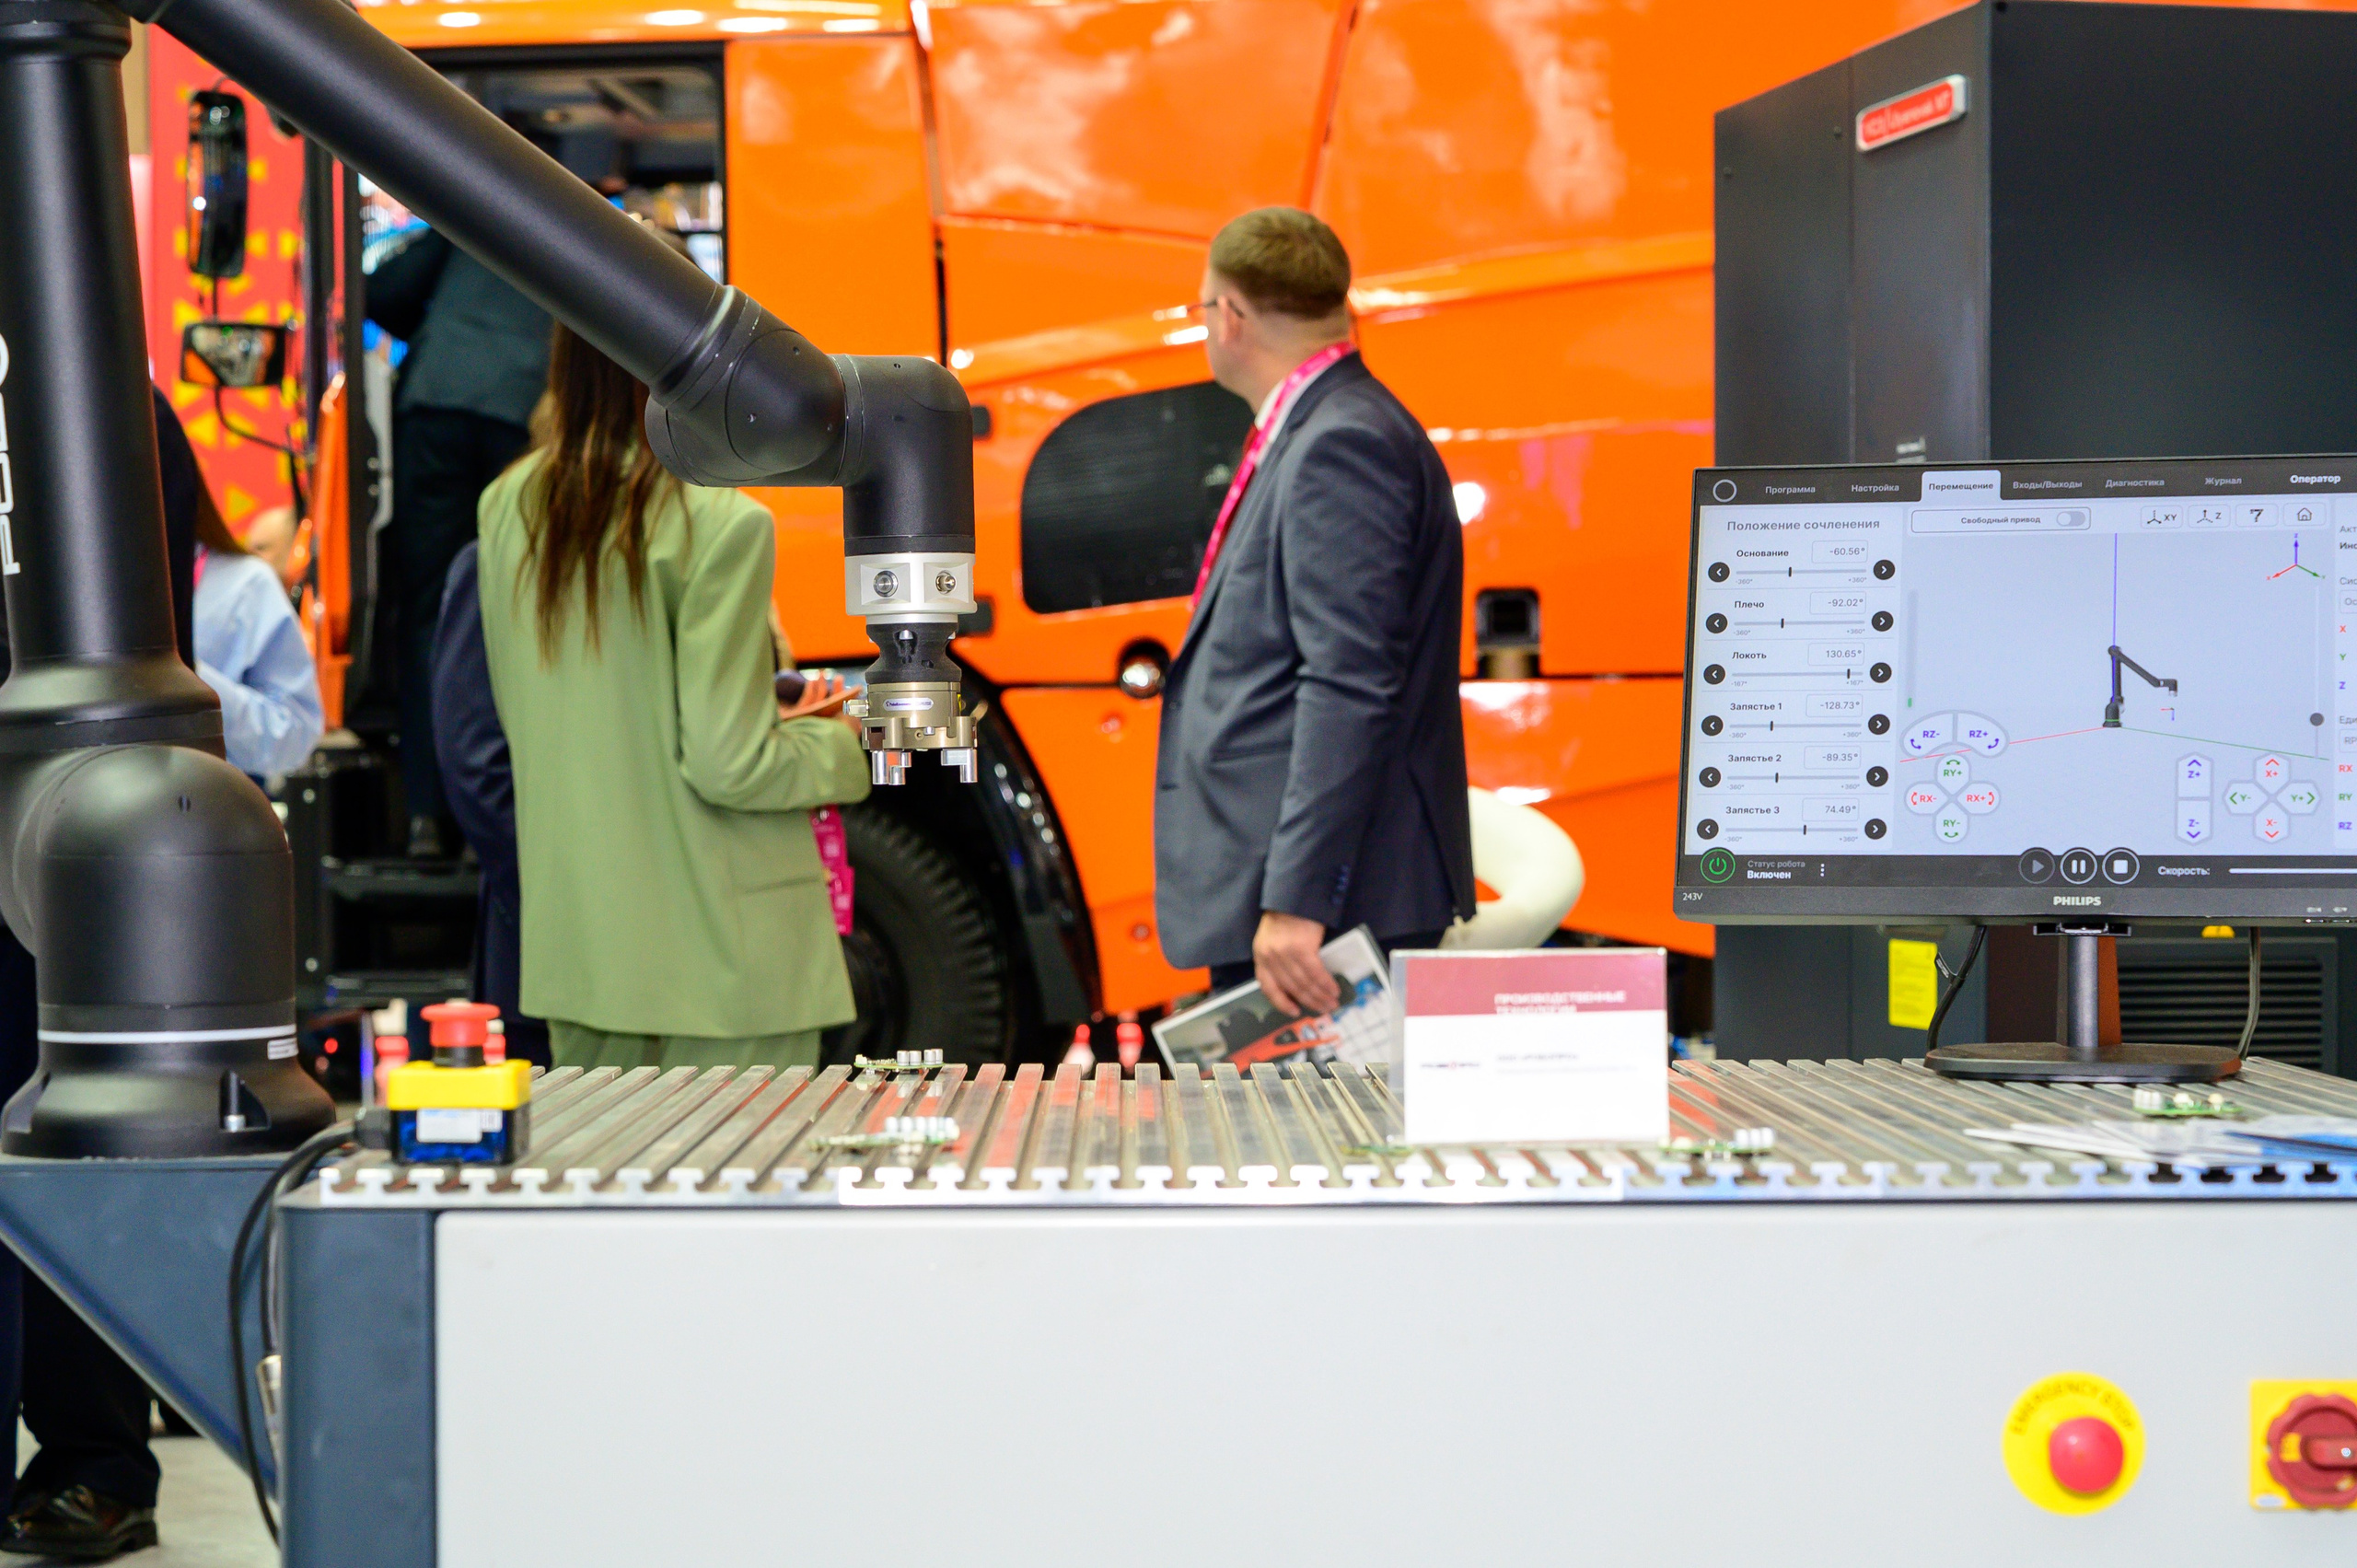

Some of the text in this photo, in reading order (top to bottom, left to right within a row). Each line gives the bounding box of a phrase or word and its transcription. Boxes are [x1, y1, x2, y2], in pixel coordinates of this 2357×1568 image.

[2105, 479, 2165, 489] Диагностика
[2204, 477, 2243, 486] Журнал
[2290, 474, 2341, 485] Оператор
[1765, 484, 1816, 495] Программа
[1851, 483, 1899, 494] Настройка
[1928, 482, 1994, 492] Перемещение
[2013, 480, 2083, 490] Входы/Выходы
[2215, 512, 2222, 520] Z
[1726, 520, 1880, 531] Положение сочленения
[1960, 517, 2041, 525] Свободный привод
[1736, 549, 1789, 558] Основание
[1829, 547, 1865, 556] -60.56°
[1734, 600, 1765, 609] Плечо
[1828, 598, 1864, 608] -92.02°
[1732, 651, 1767, 659] Локоть
[1826, 649, 1863, 658] 130.65°
[2339, 653, 2347, 661] Y
[2339, 680, 2346, 690] Z
[1729, 703, 1776, 711] Запястье
[1922, 730, 1940, 738] RZ-
[1968, 729, 1988, 738] RZ+
[1727, 753, 1782, 762] Запястье 2
[2339, 764, 2352, 772] RX
[1943, 769, 1962, 777] RY+
[2188, 770, 2200, 779] Z+
[2266, 770, 2278, 778] X+
[1919, 795, 1937, 803] RX-
[1966, 794, 1986, 802] RX+
[2240, 794, 2251, 802] Y-
[2291, 794, 2304, 802] Y+
[2338, 793, 2352, 801] RY
[1725, 806, 1780, 815] Запястье 3
[1825, 805, 1857, 814] 74.49°
[1943, 819, 1960, 828] RY-
[2188, 819, 2200, 828] Z-
[2266, 819, 2278, 827] X-
[2339, 821, 2352, 830] RZ
[1747, 860, 1805, 870] Статус робота
[1747, 869, 1792, 879] Включен
[2157, 865, 2211, 877] Скорость:
[1682, 892, 1703, 901] 243V
[2053, 895, 2102, 907] PHILIPS
